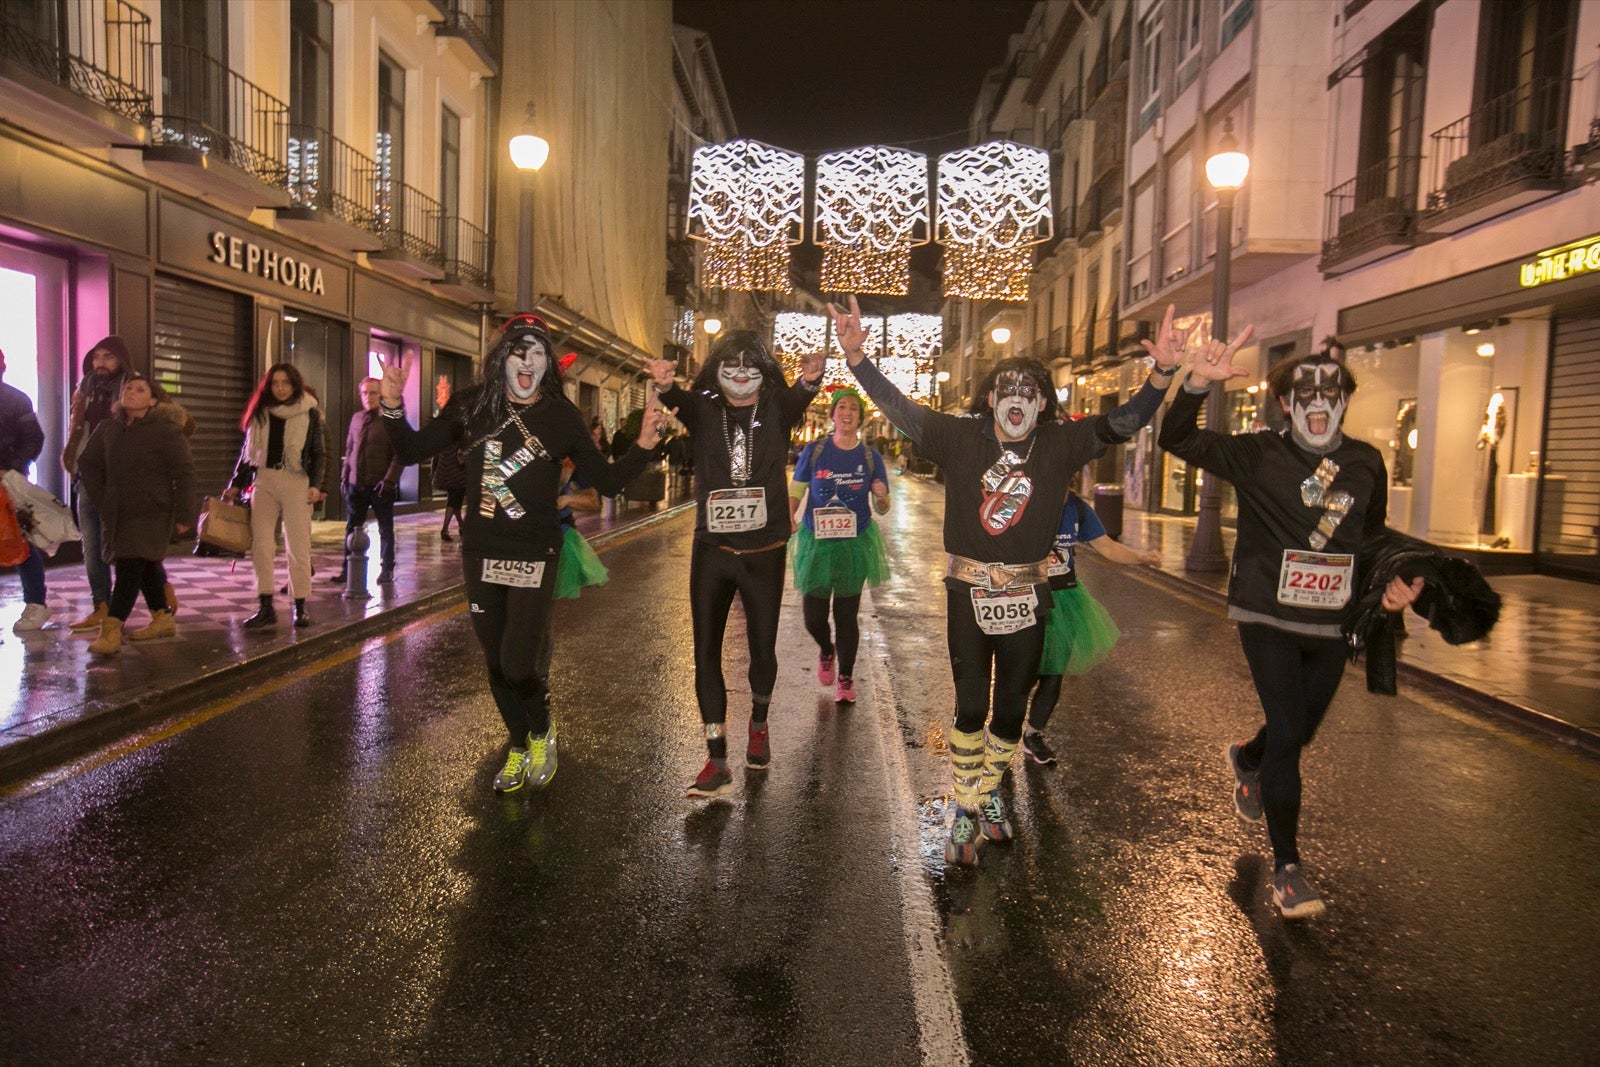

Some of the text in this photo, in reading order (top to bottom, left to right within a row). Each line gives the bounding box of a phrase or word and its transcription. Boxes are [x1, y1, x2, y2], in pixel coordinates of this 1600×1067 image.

[211, 231, 325, 296] SEPHORA
[714, 504, 758, 520] 2217
[820, 518, 851, 529] 1132
[491, 559, 536, 575] 2045
[1288, 570, 1343, 591] 2202
[981, 602, 1030, 620] 2058
